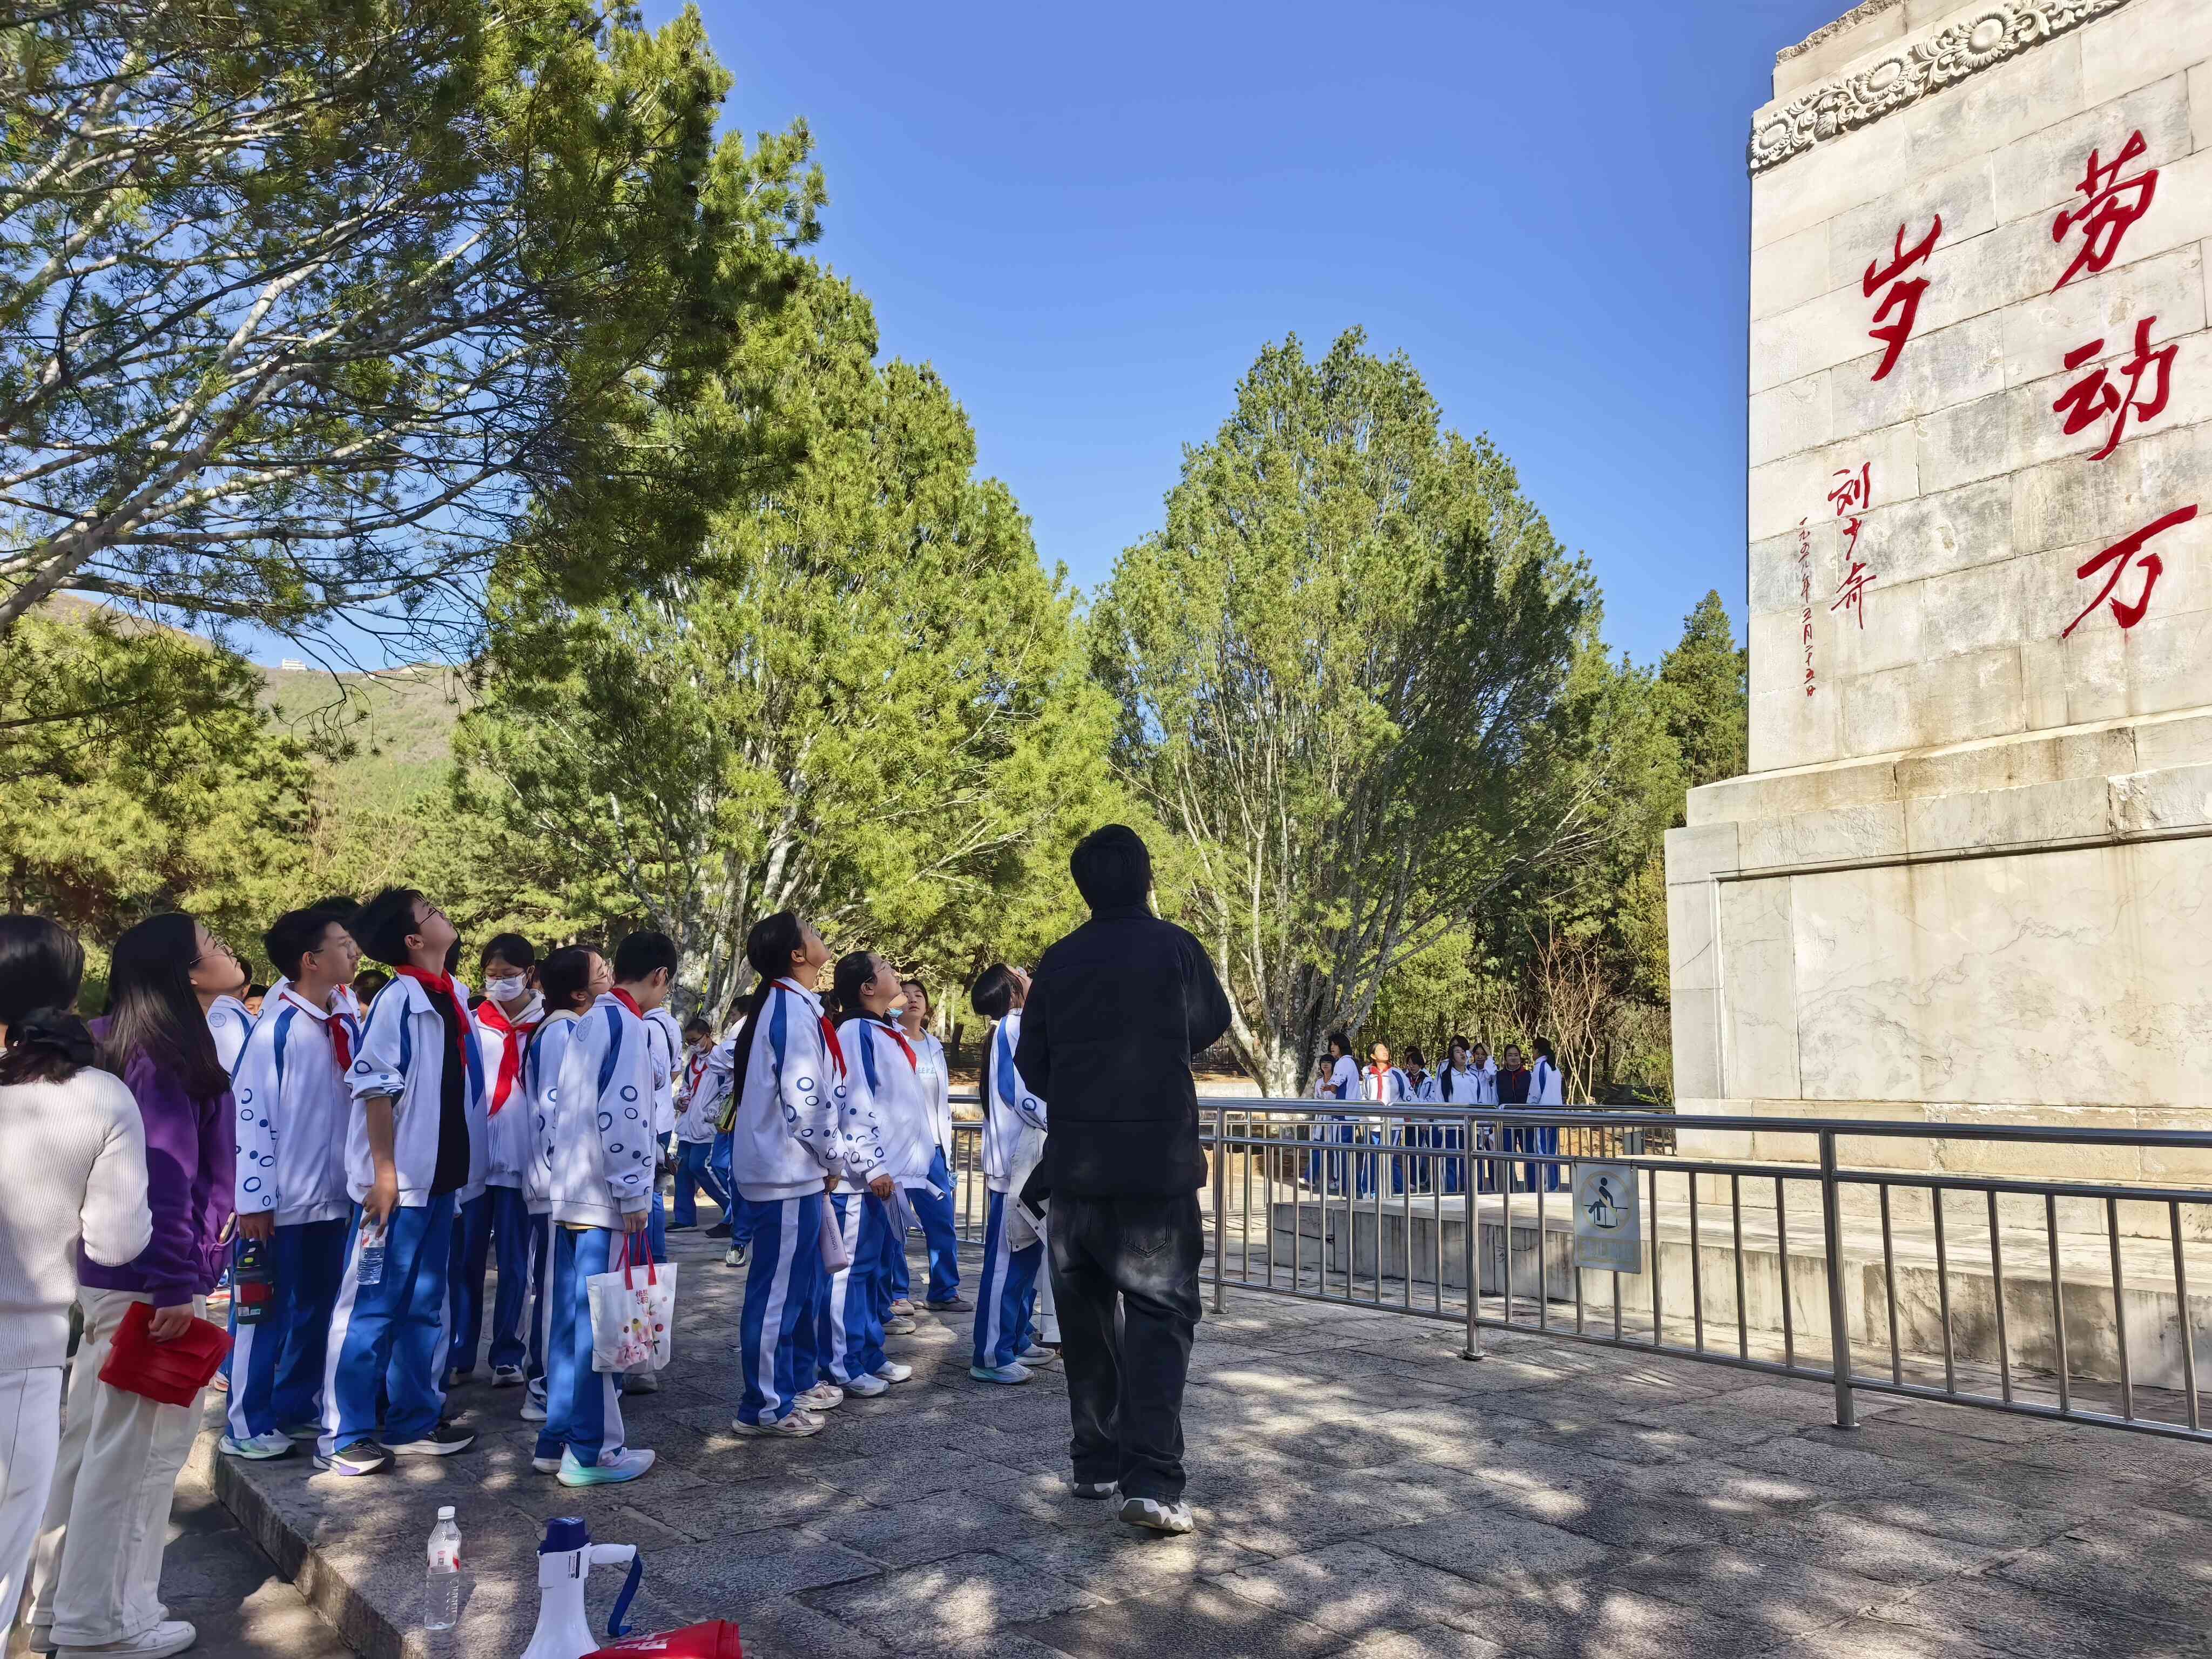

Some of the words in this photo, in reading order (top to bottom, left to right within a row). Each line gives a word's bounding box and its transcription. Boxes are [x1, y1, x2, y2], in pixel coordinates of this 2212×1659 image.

[1863, 214, 1942, 382] 岁
[2050, 130, 2198, 640] 劳动万
[1827, 462, 1876, 629] 刘少奇
